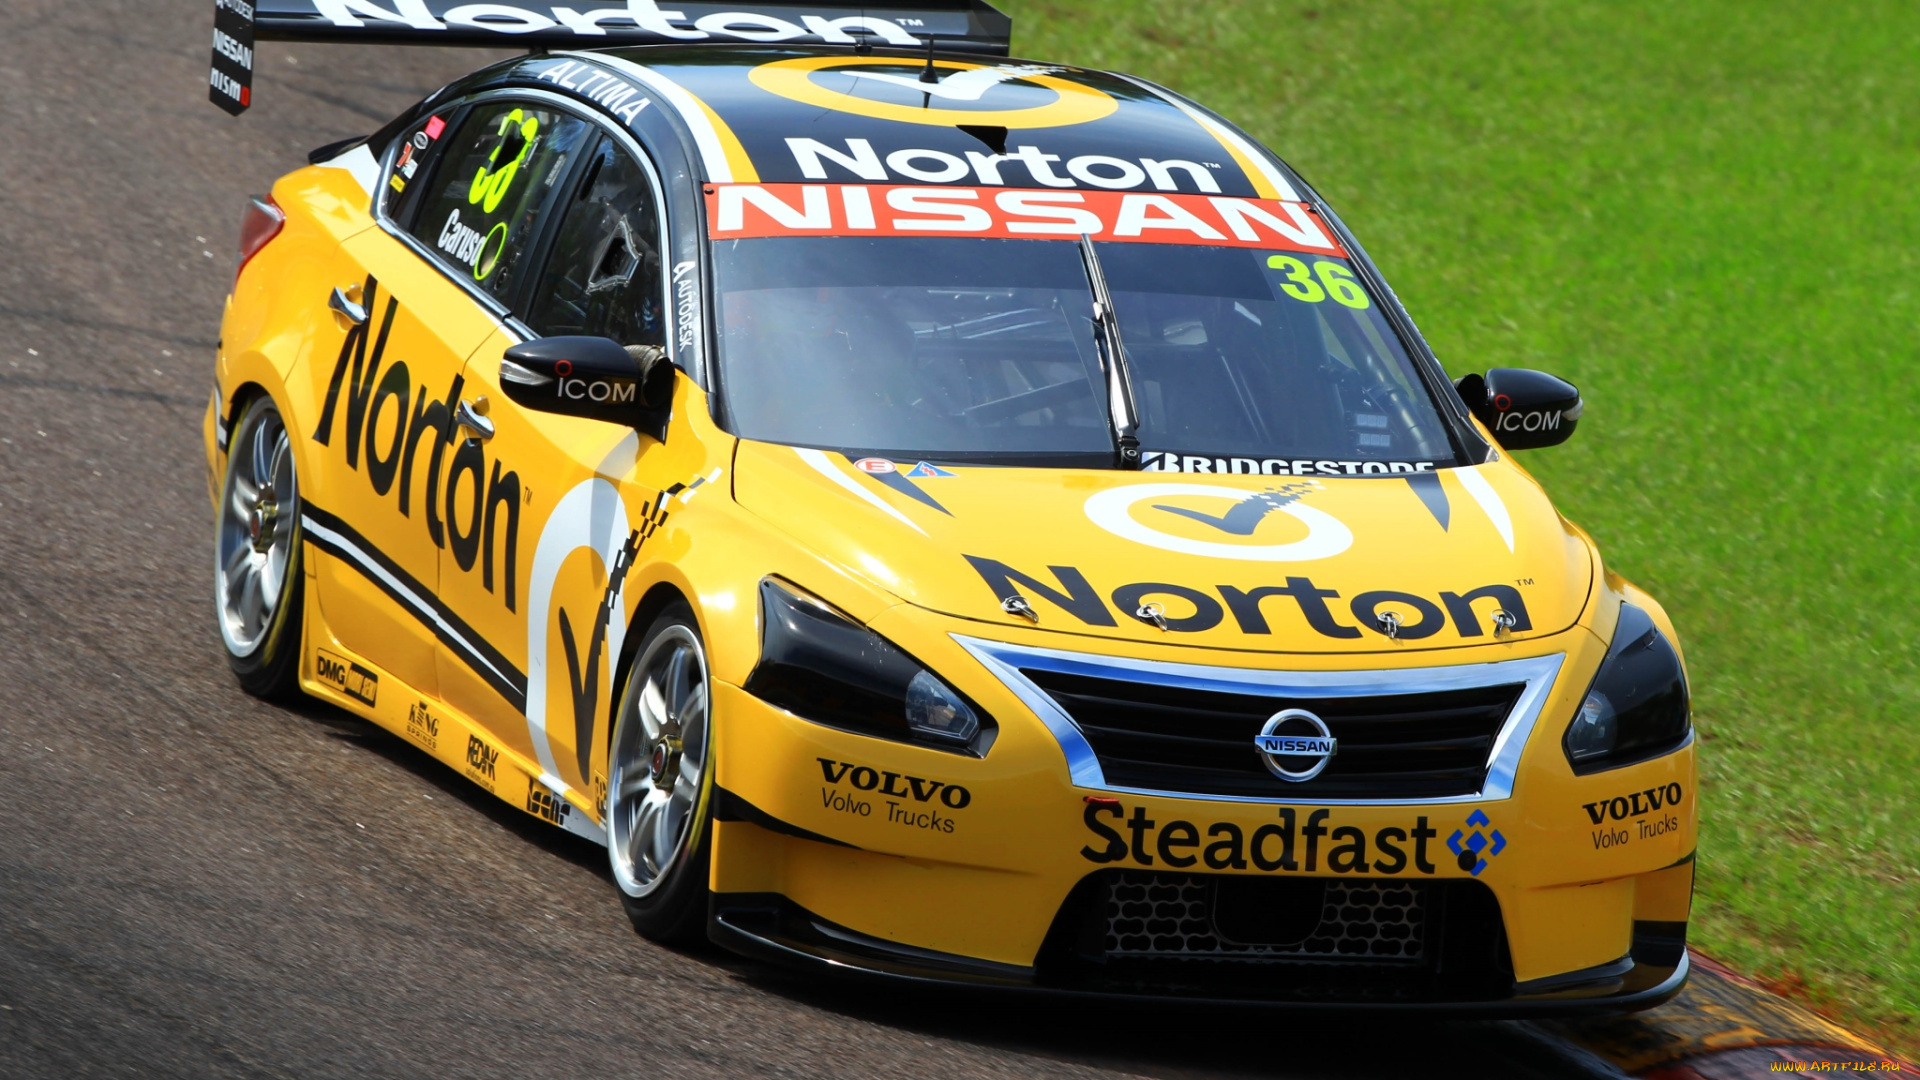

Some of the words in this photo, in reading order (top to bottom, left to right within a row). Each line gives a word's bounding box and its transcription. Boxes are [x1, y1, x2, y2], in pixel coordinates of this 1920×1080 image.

[212, 27, 253, 71] NISSAN
[312, 0, 922, 46] Norton
[537, 60, 651, 127] ALTIMA
[785, 138, 1222, 193] Norton
[437, 208, 487, 267] Caruso
[716, 185, 1336, 250] NISSAN
[1266, 254, 1370, 310] 36
[678, 279, 693, 353] AUTODESK
[557, 377, 636, 402] ICOM
[312, 273, 522, 615] Norton
[1495, 410, 1561, 432] ICOM
[961, 553, 1533, 640] Norton
[317, 655, 346, 685] DMG
[1265, 740, 1330, 752] NISSAN
[816, 757, 971, 809] VOLVO
[1582, 782, 1682, 825] VOLVO
[822, 787, 872, 817] Volvo
[886, 800, 955, 834] Trucks
[1592, 827, 1629, 850] Volvo
[1637, 813, 1678, 840] Trucks
[1080, 799, 1437, 875] Steadfast
